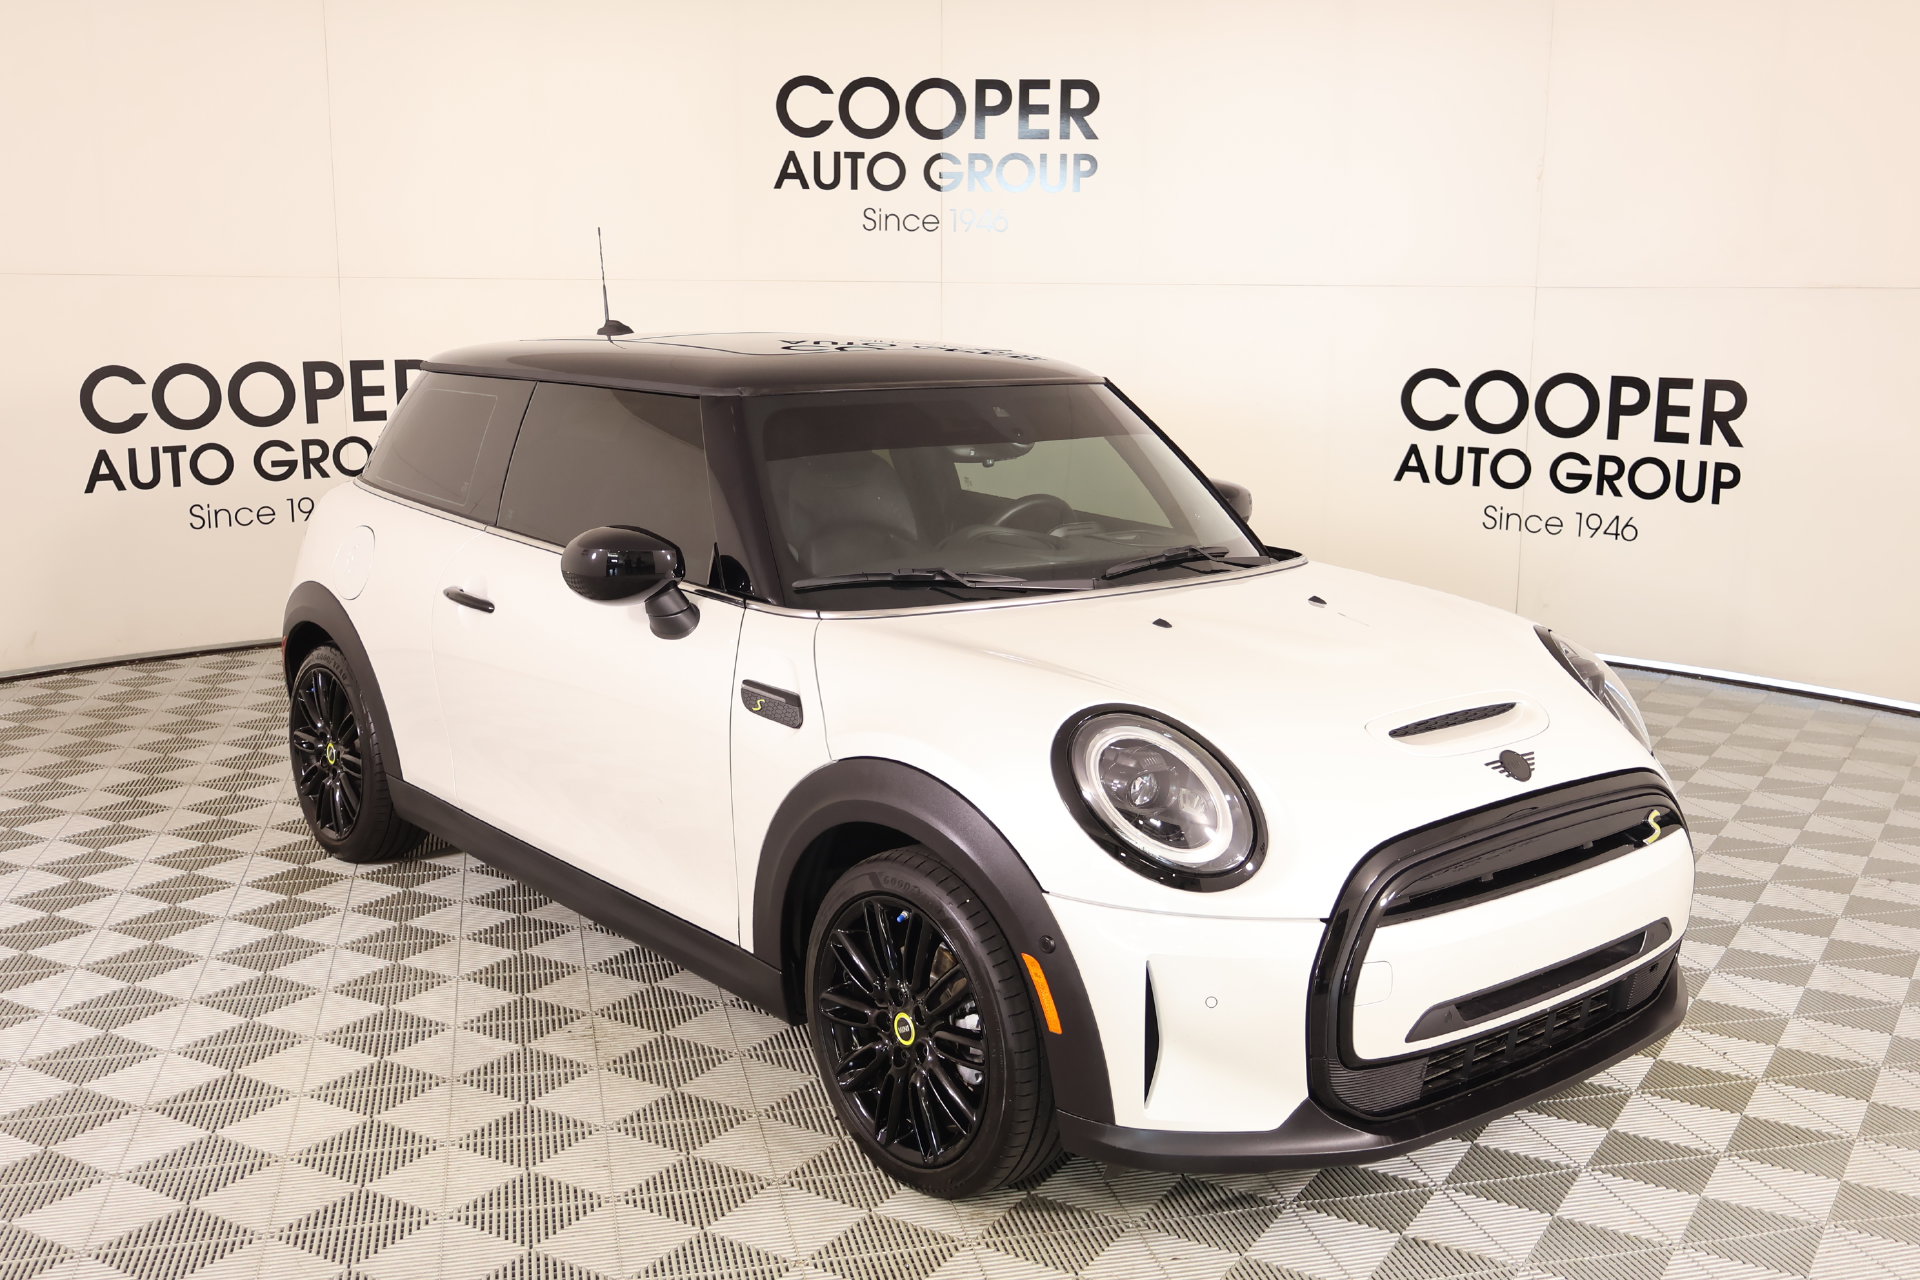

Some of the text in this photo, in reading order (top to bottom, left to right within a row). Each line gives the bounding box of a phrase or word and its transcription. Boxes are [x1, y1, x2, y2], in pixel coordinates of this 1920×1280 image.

[776, 75, 1100, 141] COOPER
[774, 150, 1098, 193] AUTO GROUP
[862, 207, 1009, 233] Since 1946
[1400, 367, 1748, 448] COOPER
[84, 435, 373, 494] AUTO GRO
[1393, 443, 1741, 505] AUTO GROUP
[189, 496, 315, 530] Since 19
[1482, 505, 1639, 542] Since 1946
[752, 698, 766, 711] S
